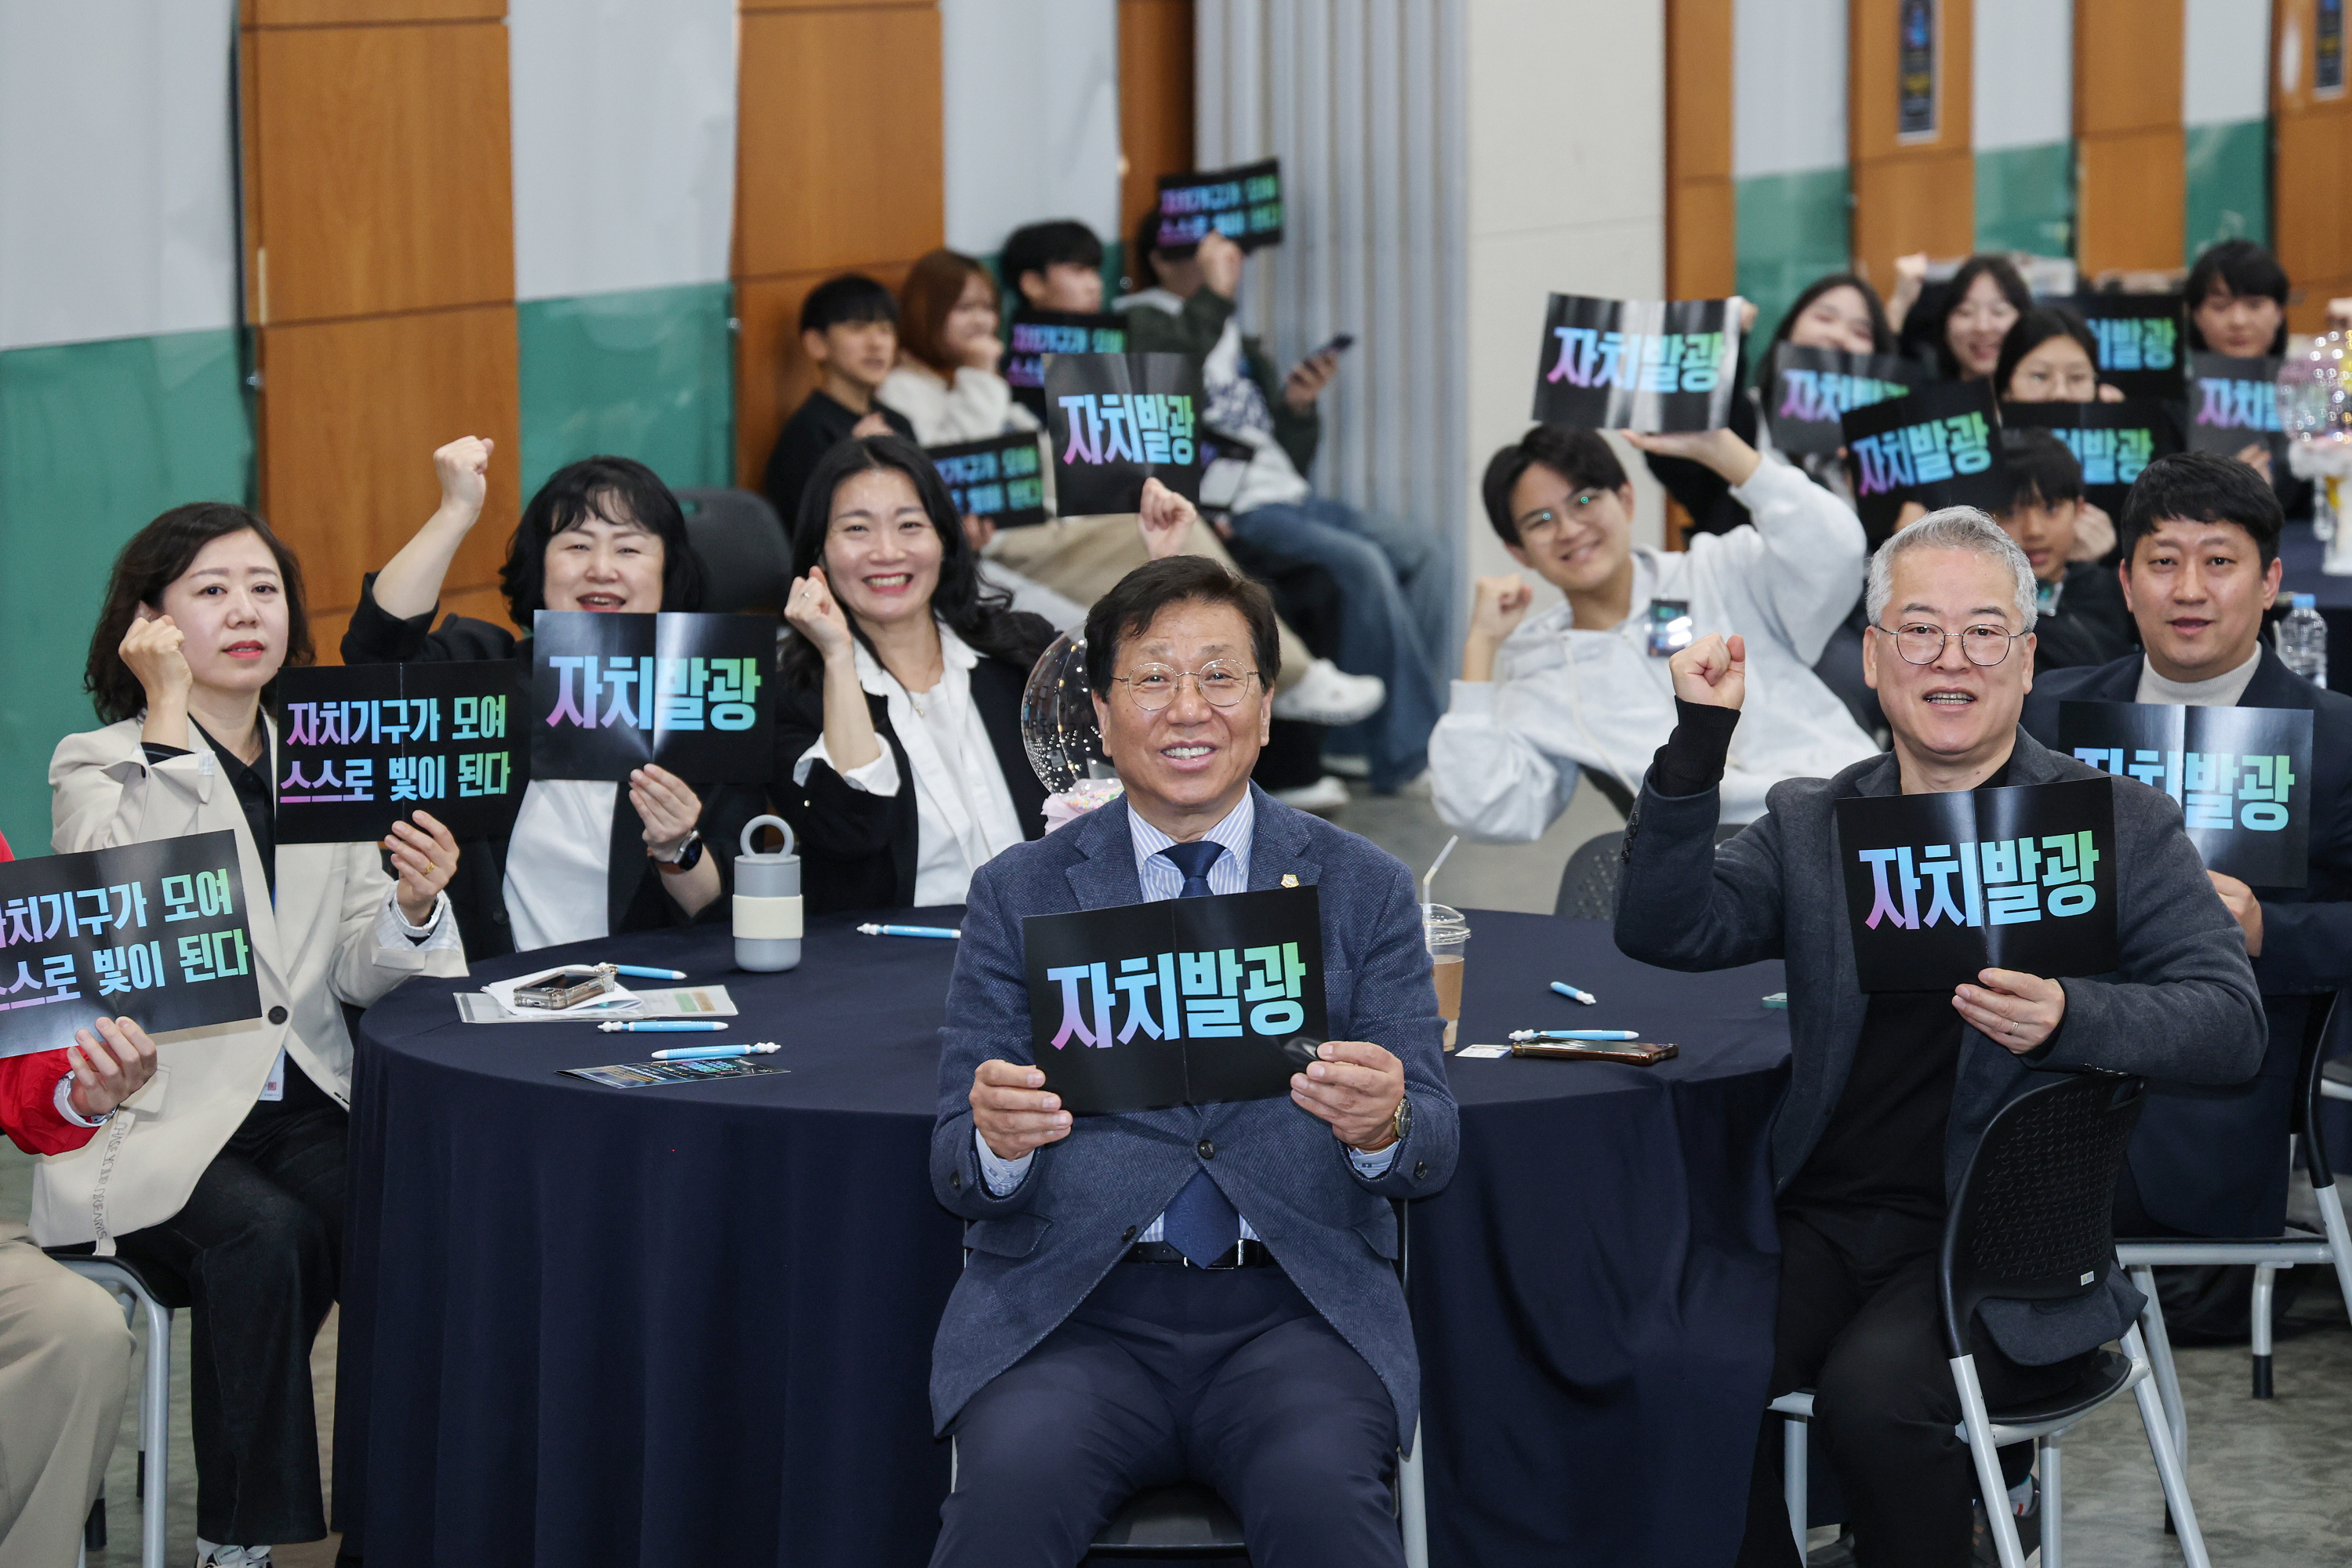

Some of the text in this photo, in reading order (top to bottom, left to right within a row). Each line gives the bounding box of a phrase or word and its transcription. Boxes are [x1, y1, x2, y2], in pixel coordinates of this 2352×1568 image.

[1546, 326, 1726, 393] 자치발광
[2086, 318, 2177, 371] 발광
[1779, 368, 1909, 423] 자치
[2197, 377, 2283, 430] 자치
[1058, 394, 1196, 466] 자치발광
[1851, 411, 1991, 496] 자치발광
[2052, 428, 2154, 485] 발광
[286, 695, 506, 746] 자치기구가 모여
[546, 656, 761, 731] 자치발광
[280, 751, 510, 803] 스스로 빛이 된다
[162, 869, 233, 922] 모여
[1859, 830, 2100, 930] 자치발광
[0, 928, 249, 1011] 스로 빛이 된다
[1047, 942, 1306, 1051] 자치발광
